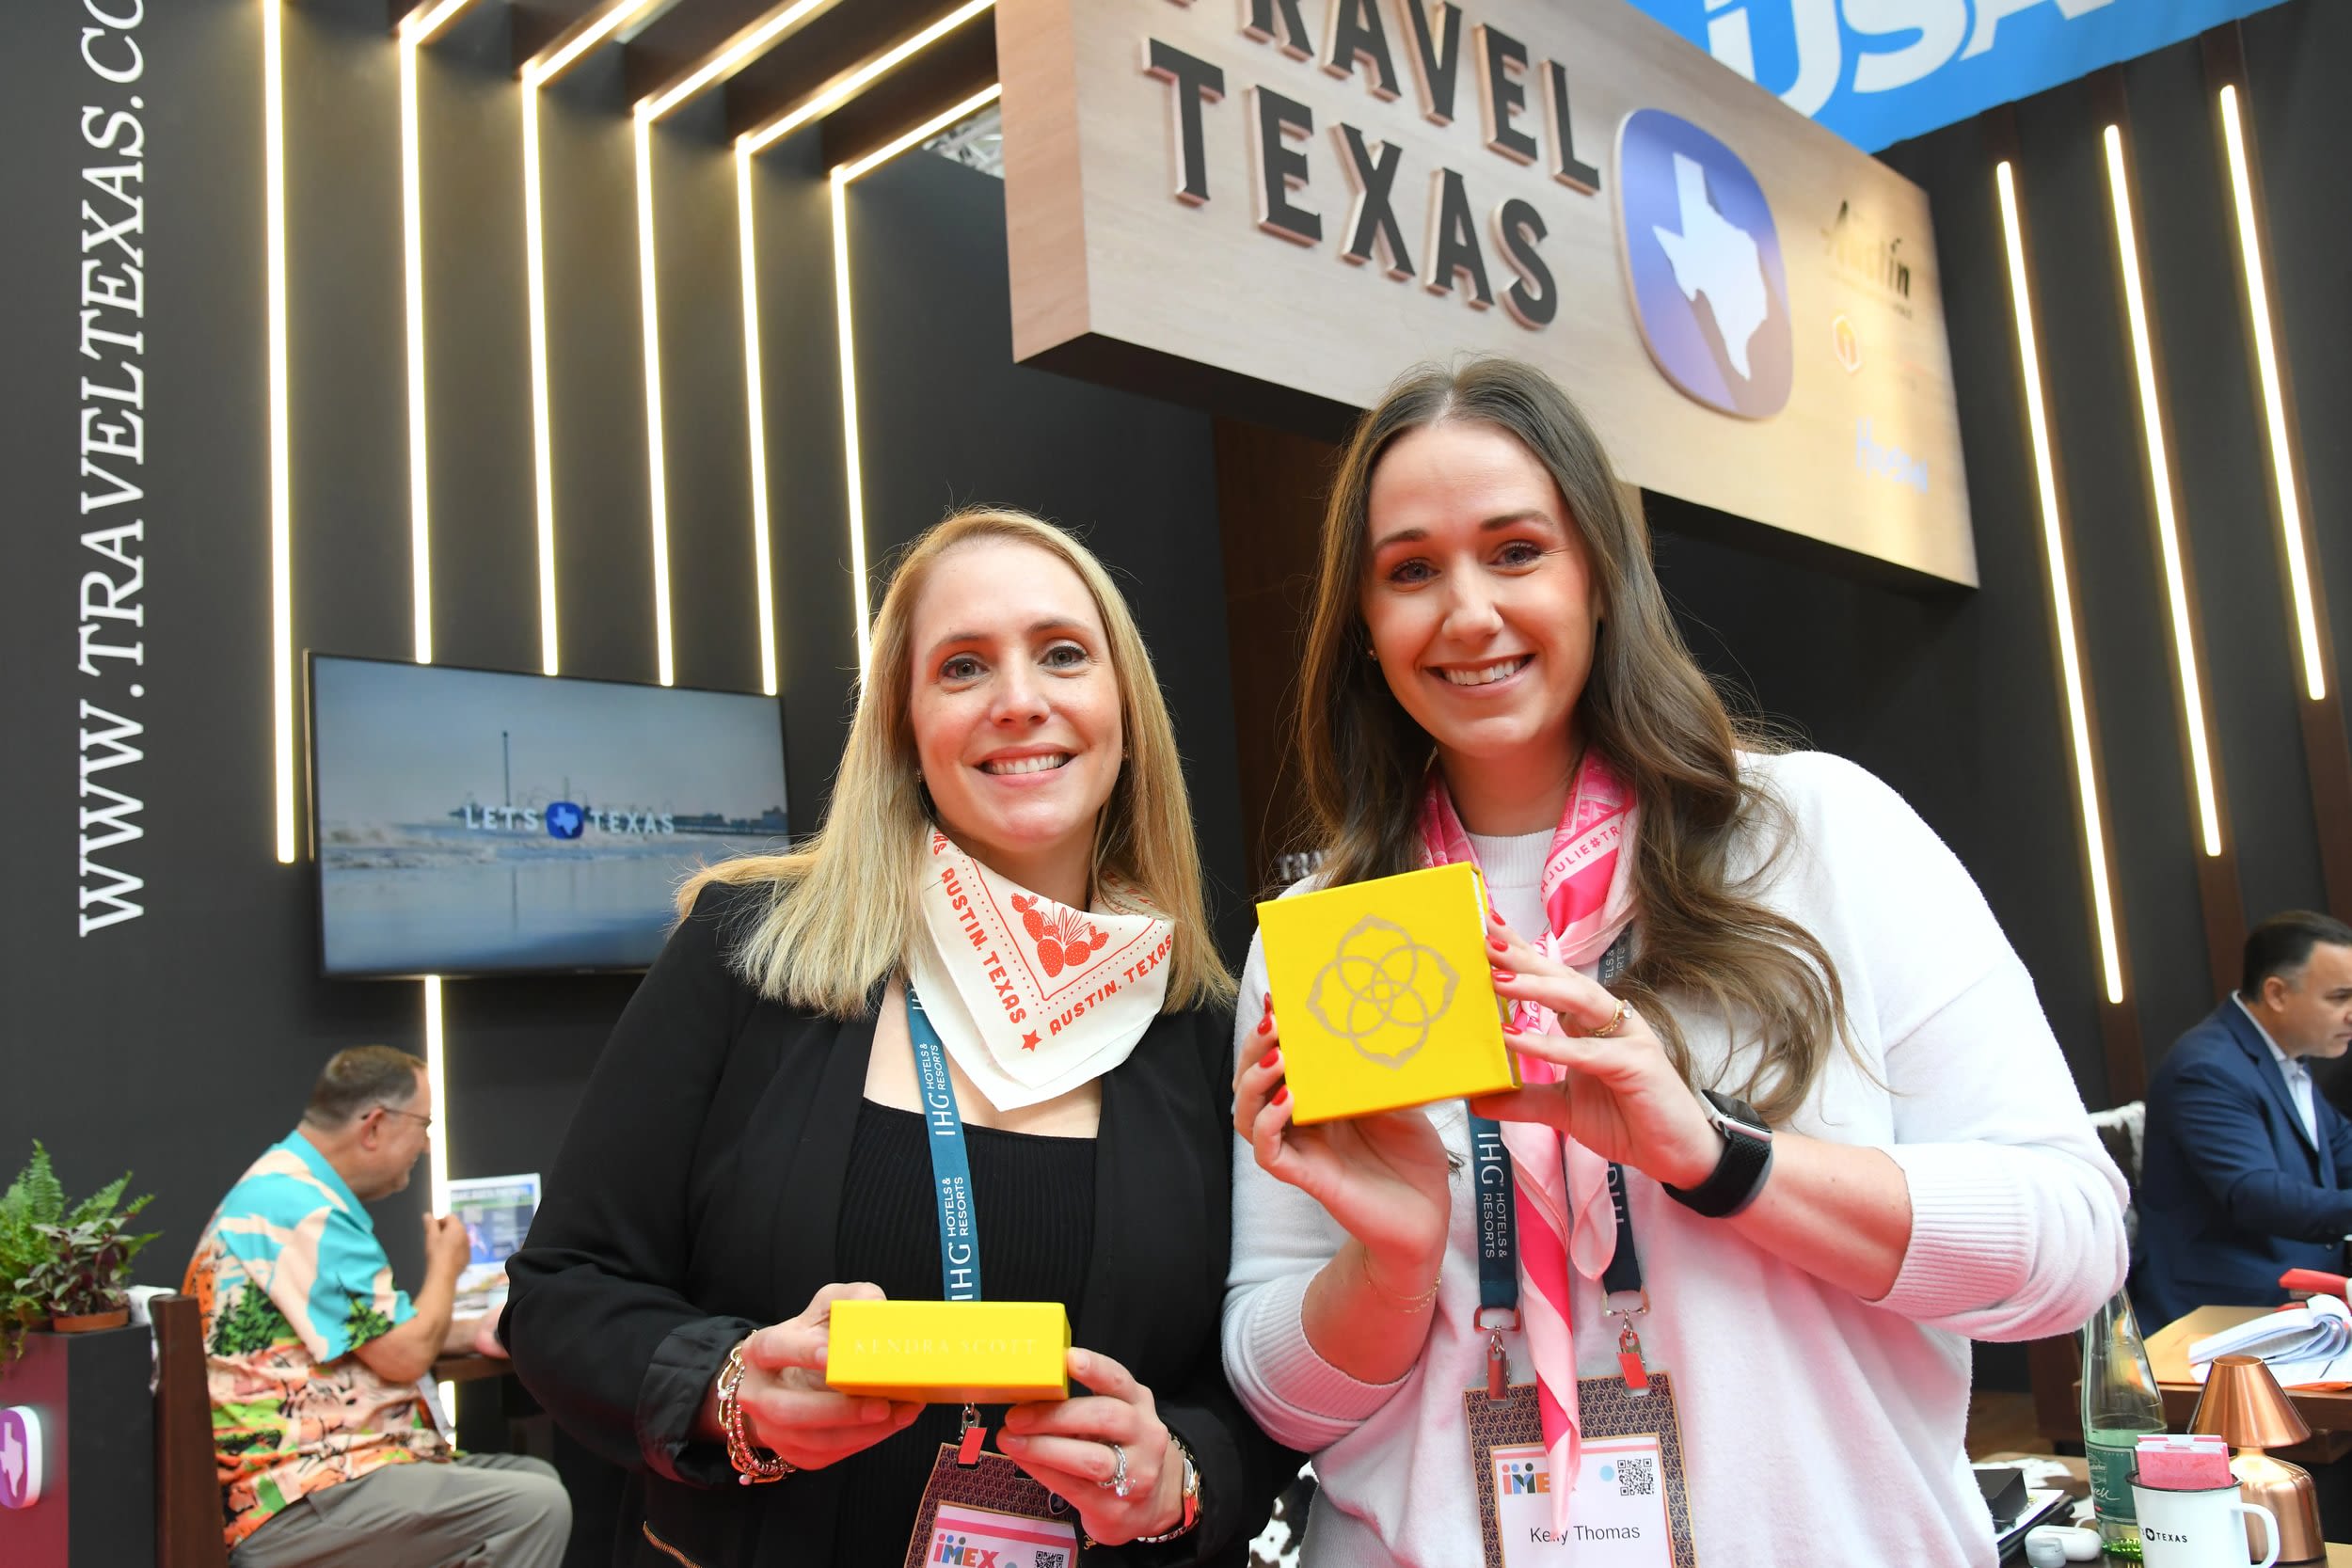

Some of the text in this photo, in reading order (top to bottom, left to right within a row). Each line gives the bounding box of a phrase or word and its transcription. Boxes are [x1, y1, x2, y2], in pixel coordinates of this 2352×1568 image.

[1704, 0, 2119, 119] US
[1171, 0, 1600, 195] AVEL
[1142, 37, 1559, 332] TEXAS
[589, 811, 675, 835] TEXAS
[941, 867, 1026, 1024] AUSTIN, TEXAS
[1049, 934, 1172, 1037] AUSTIN, TEXAS
[930, 1045, 946, 1090] RESORTS
[928, 1092, 957, 1135] IHG
[1478, 1132, 1503, 1186] IHG
[954, 1177, 969, 1236] RESORTS
[1483, 1193, 1495, 1258] RESORTS
[1496, 1192, 1507, 1247] HOTELS
[948, 1242, 973, 1300] IHG
[854, 1338, 1038, 1355] KENDRA SCOTT
[1530, 1525, 1641, 1545] Key Thomas
[2155, 1531, 2187, 1543] TEXAS
